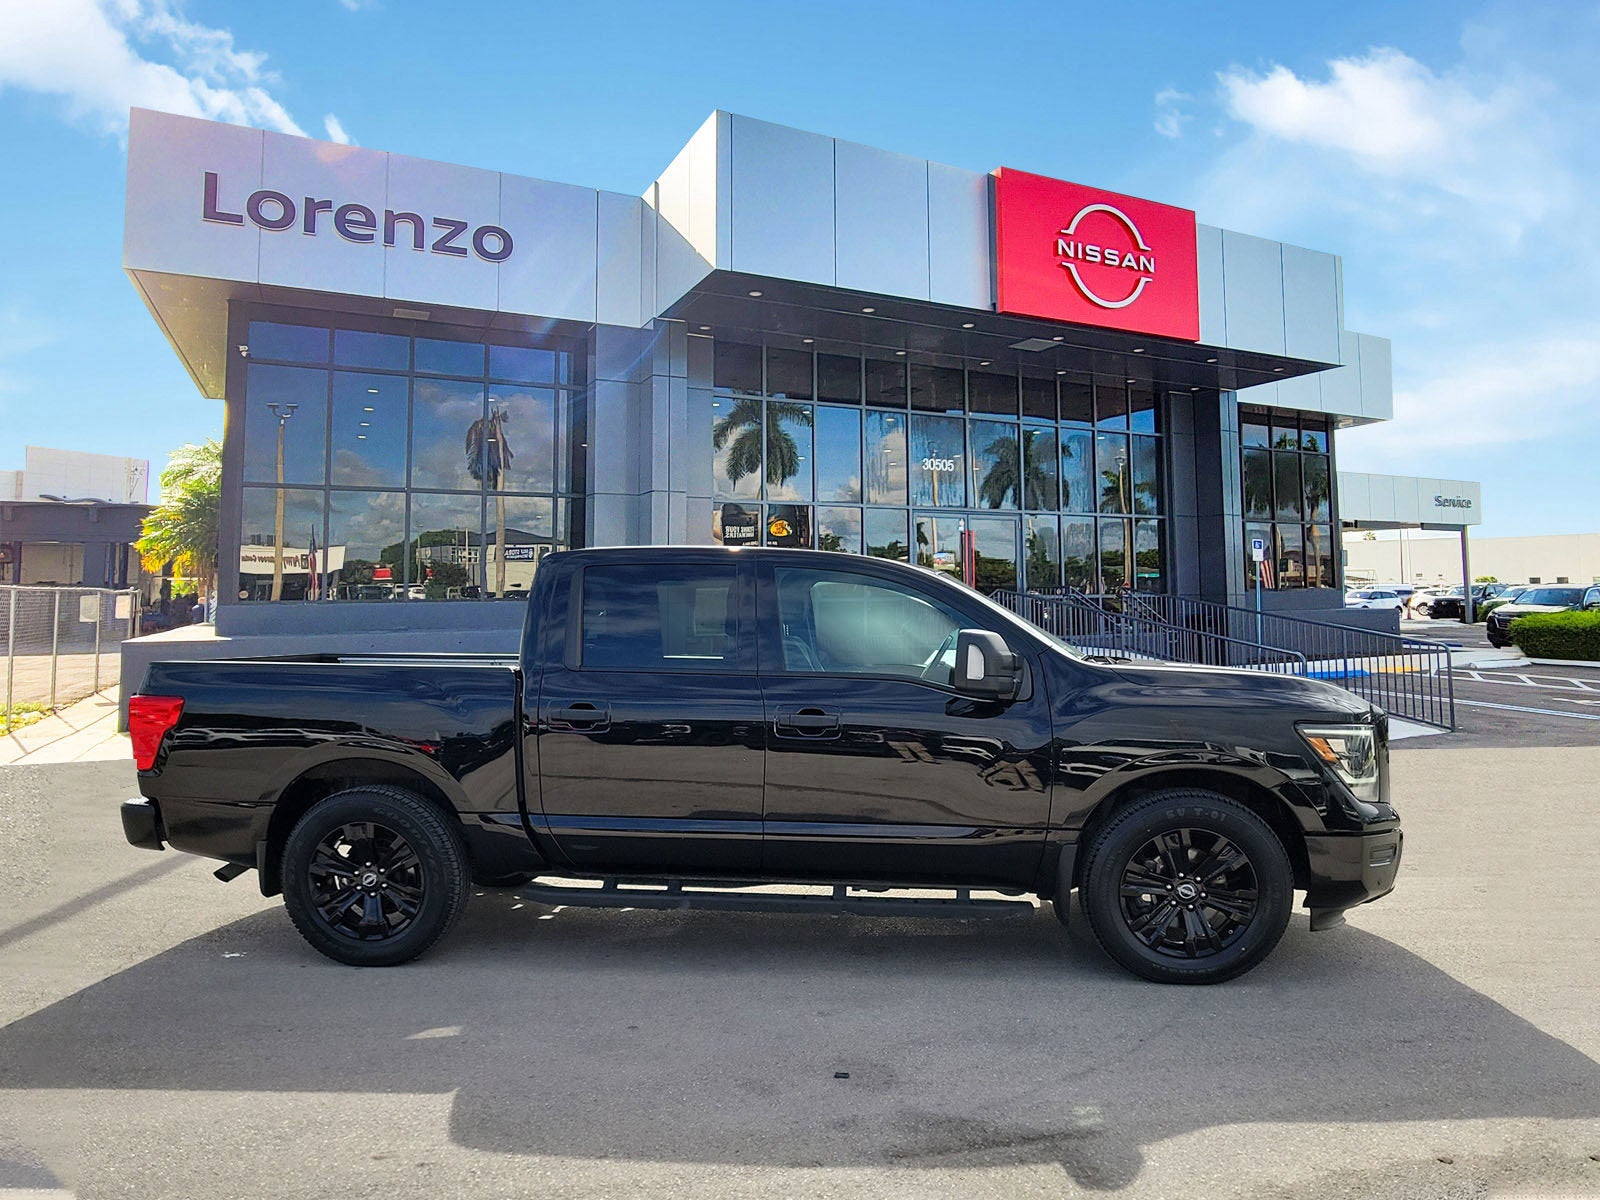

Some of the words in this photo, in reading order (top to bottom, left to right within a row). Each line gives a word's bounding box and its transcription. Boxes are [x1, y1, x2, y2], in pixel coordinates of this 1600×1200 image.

[202, 171, 514, 262] Lorenzo
[1057, 238, 1155, 273] NISSAN
[922, 458, 954, 471] 30505
[1434, 495, 1472, 509] Service
